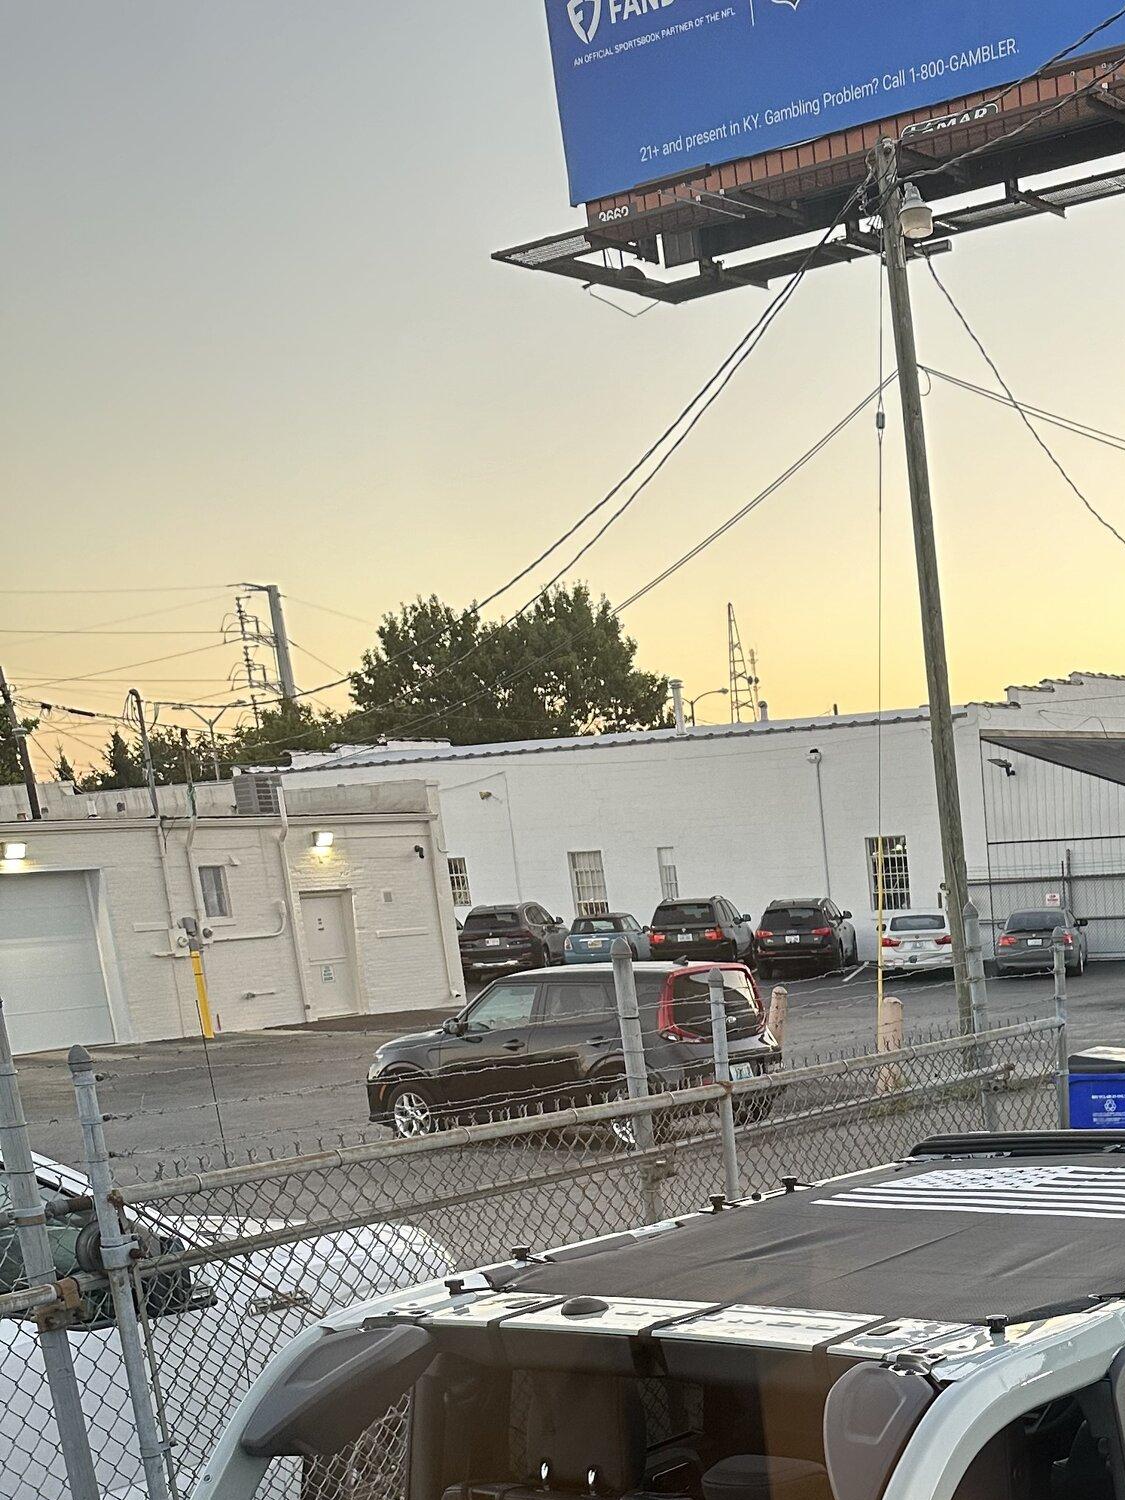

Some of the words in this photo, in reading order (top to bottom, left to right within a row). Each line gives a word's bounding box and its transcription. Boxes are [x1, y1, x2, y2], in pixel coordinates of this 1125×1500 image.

[573, 57, 584, 67] AN
[584, 50, 614, 64] OFFICIAL
[614, 31, 661, 54] SPORTSBOOK
[661, 20, 695, 40] PARTNER
[695, 17, 705, 28] OF
[705, 13, 721, 26] THE
[721, 7, 736, 21] NFL
[639, 144, 659, 163] 21+
[662, 137, 683, 156] and
[685, 123, 728, 152] present
[729, 122, 740, 137] in
[742, 112, 762, 133] KY.
[764, 98, 820, 125] Gambling
[823, 77, 879, 109] Problem?
[882, 70, 906, 91] Call
[908, 37, 1020, 83] 1-800-GAMBLER.
